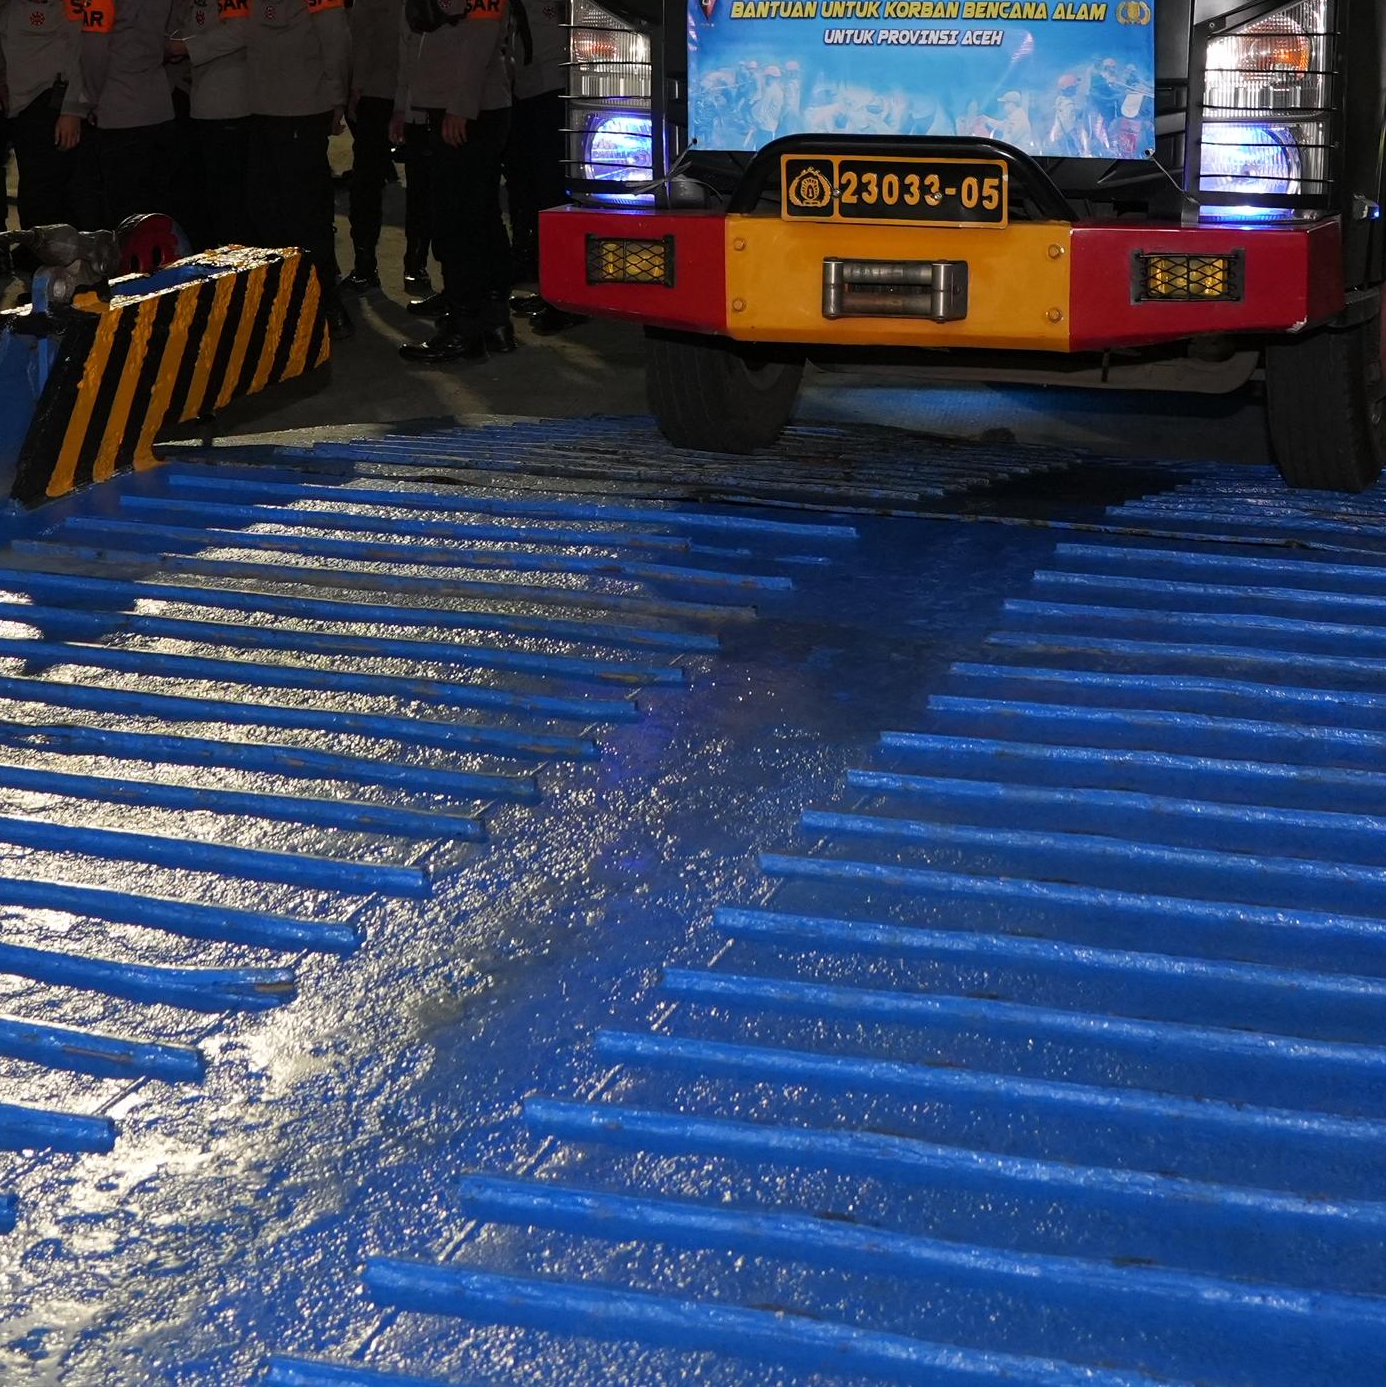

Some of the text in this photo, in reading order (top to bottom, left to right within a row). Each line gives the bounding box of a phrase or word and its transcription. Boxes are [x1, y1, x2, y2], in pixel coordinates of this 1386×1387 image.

[730, 0, 1107, 22] BANTUAN UNTUK KORBAN BENCANA ALAM
[823, 28, 1005, 47] UNTUK PROVINSI ACEH
[840, 170, 1000, 211] 23033-05
